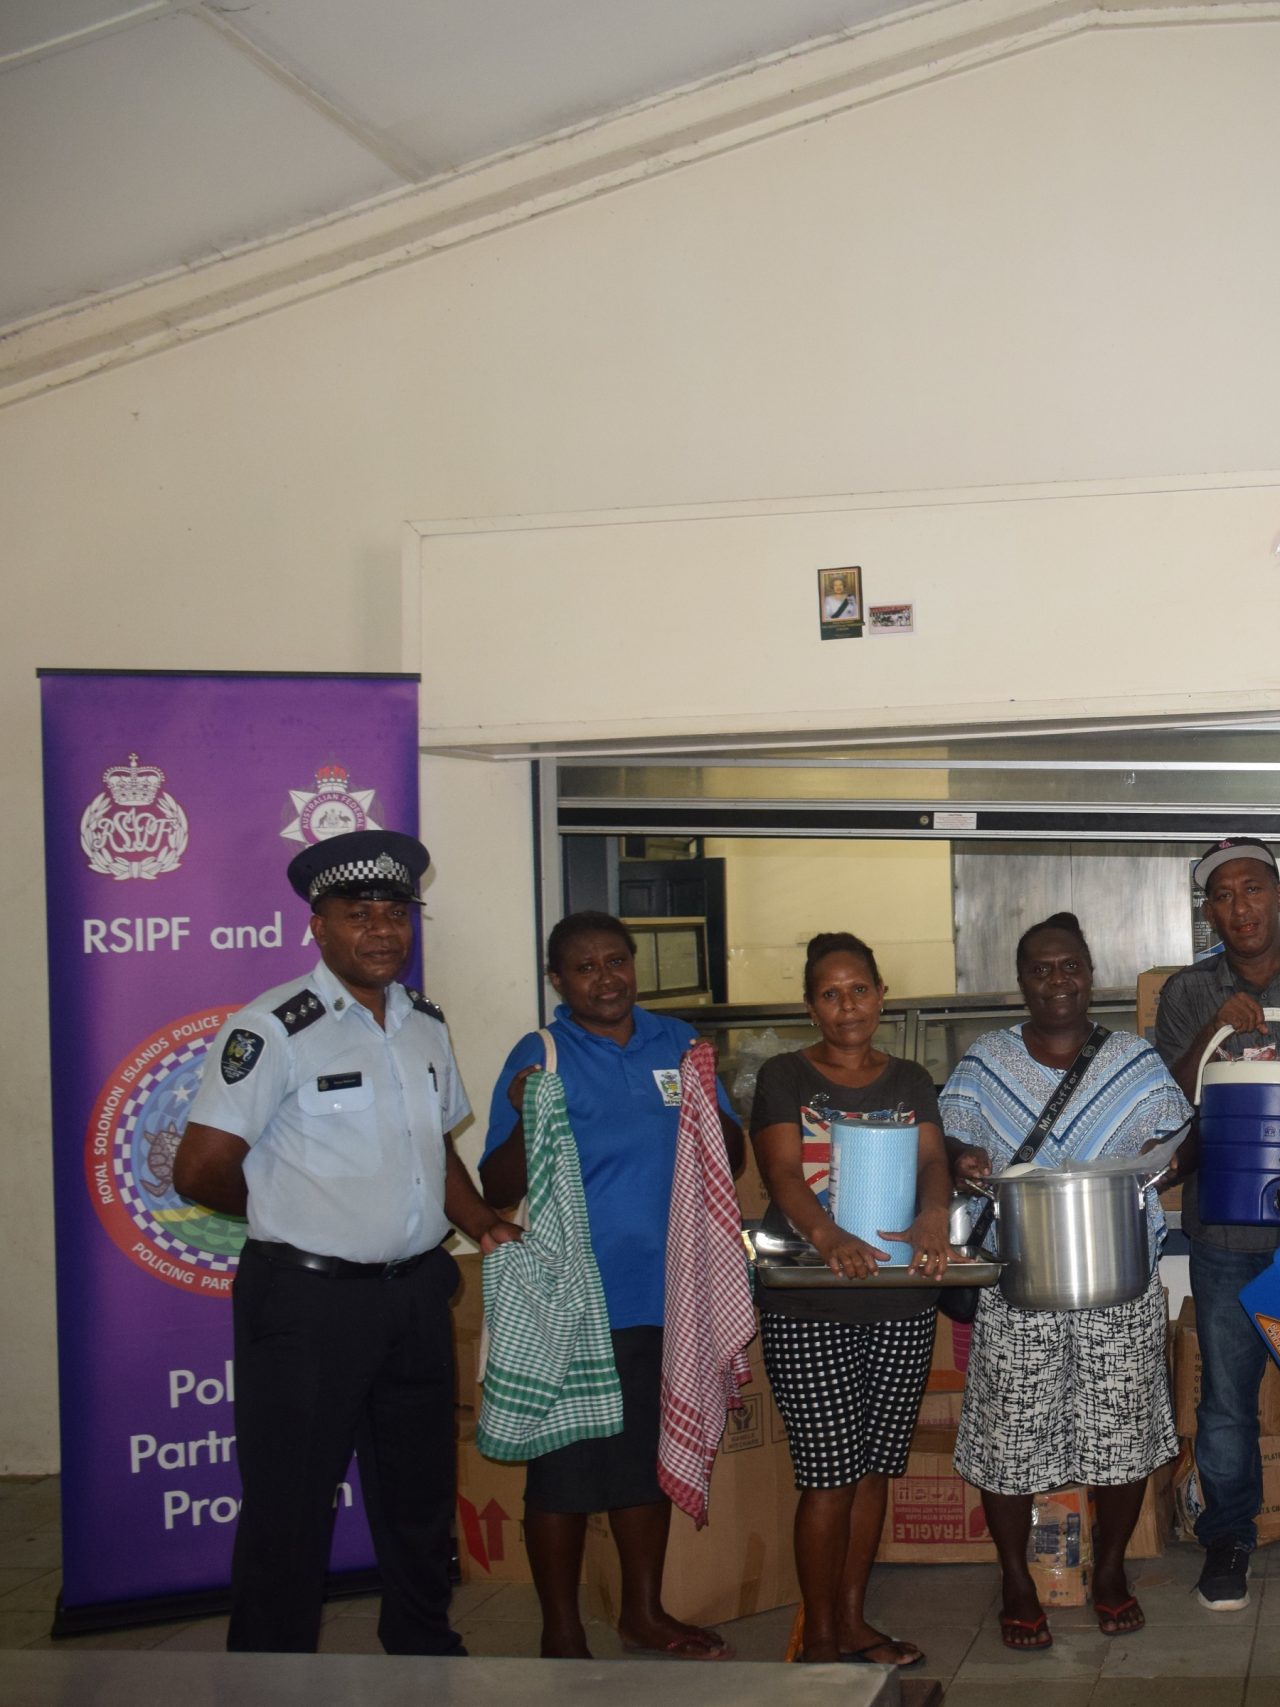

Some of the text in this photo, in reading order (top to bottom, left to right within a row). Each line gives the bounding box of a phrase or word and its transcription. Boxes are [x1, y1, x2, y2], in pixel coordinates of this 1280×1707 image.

[302, 793, 365, 830] AUSTRALIAN FEDERAL
[82, 916, 190, 954] RSIPF
[210, 911, 282, 949] and
[94, 1014, 220, 1205] ROYAL SOLOMON ISLANDS POLICE
[131, 1242, 196, 1285] POLICING
[895, 1524, 963, 1539] FRAGILE
